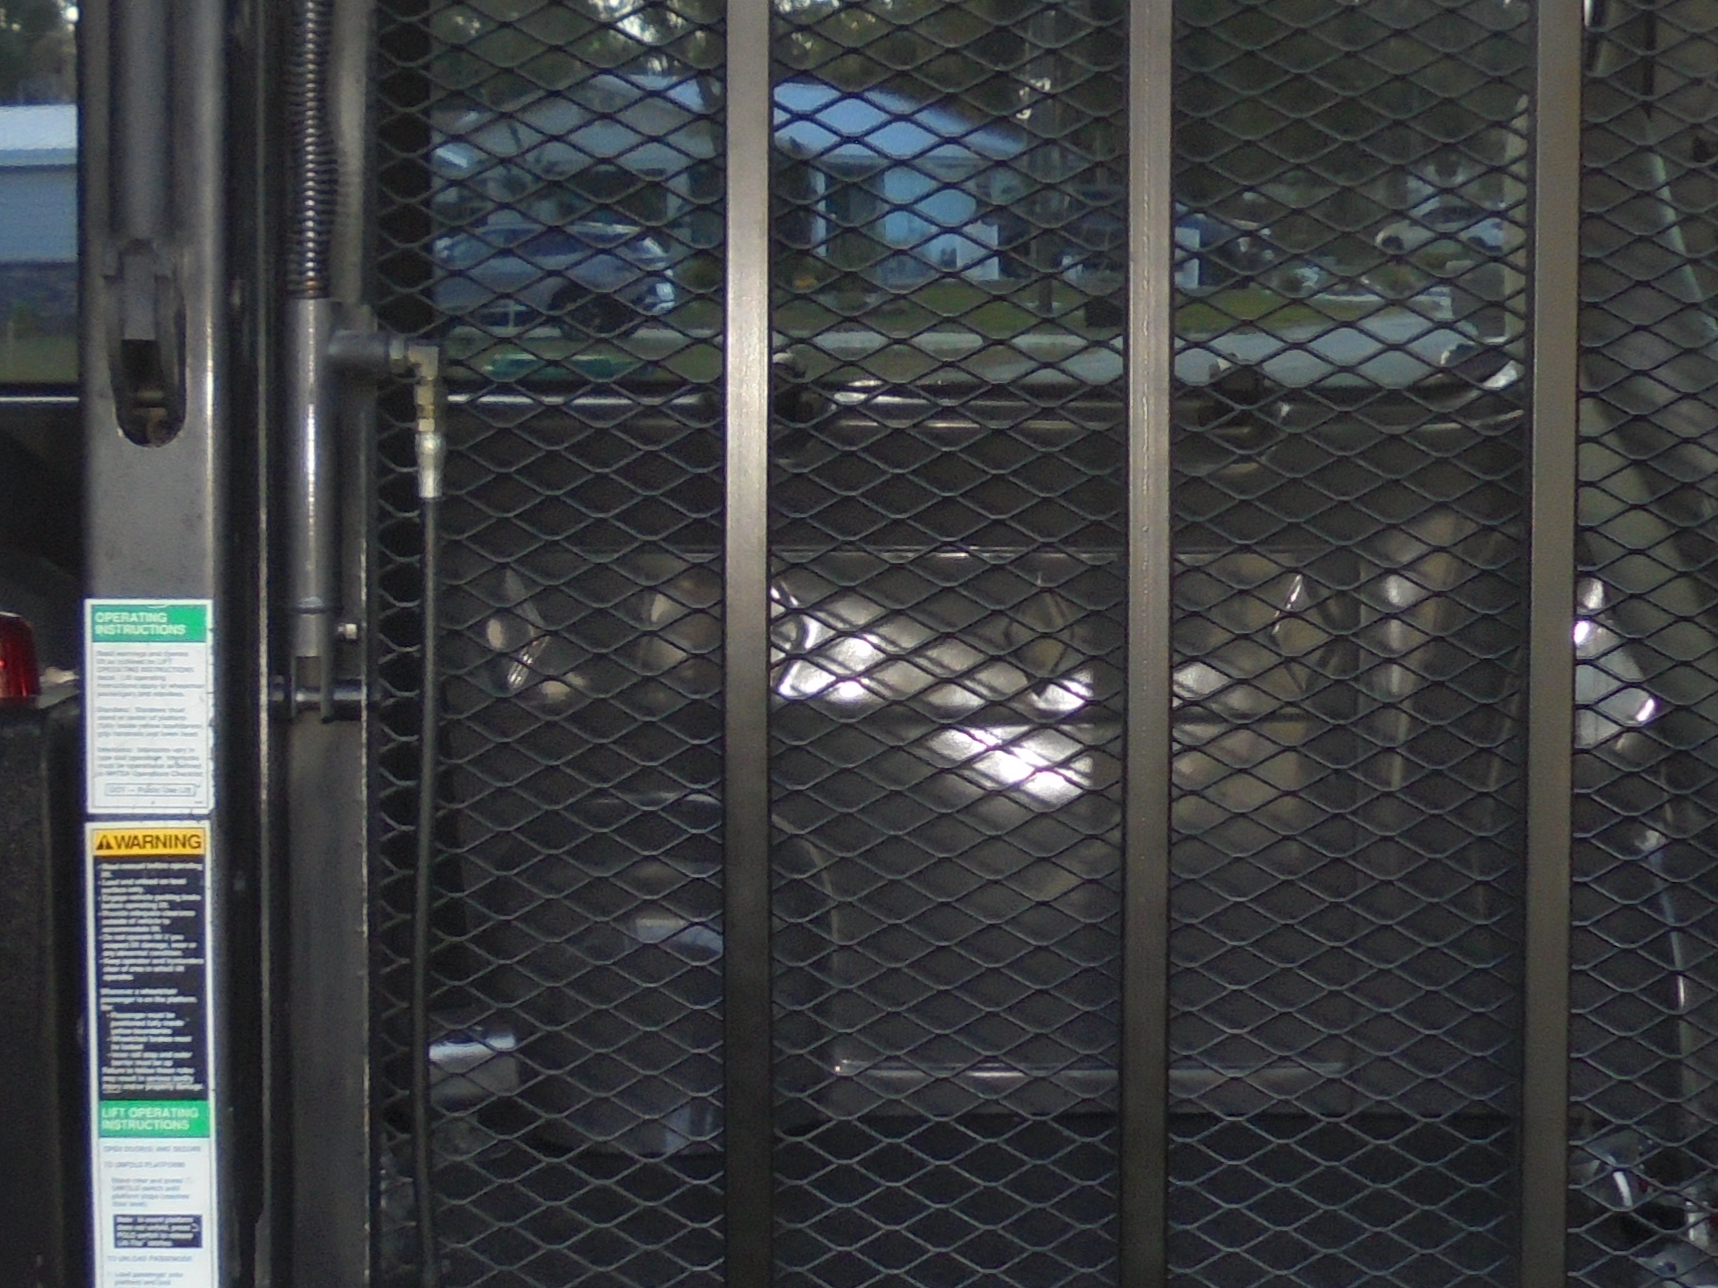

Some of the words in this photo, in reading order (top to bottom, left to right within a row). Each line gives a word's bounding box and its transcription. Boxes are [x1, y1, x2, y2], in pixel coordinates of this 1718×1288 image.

[94, 612, 167, 623] OPERATING
[94, 624, 187, 635] INSTRUCTIONS
[113, 833, 202, 850] WARNING
[102, 1107, 126, 1118] LIFT
[127, 1106, 200, 1118] OPERATING
[101, 1119, 190, 1131] INSTRUCTIONS
